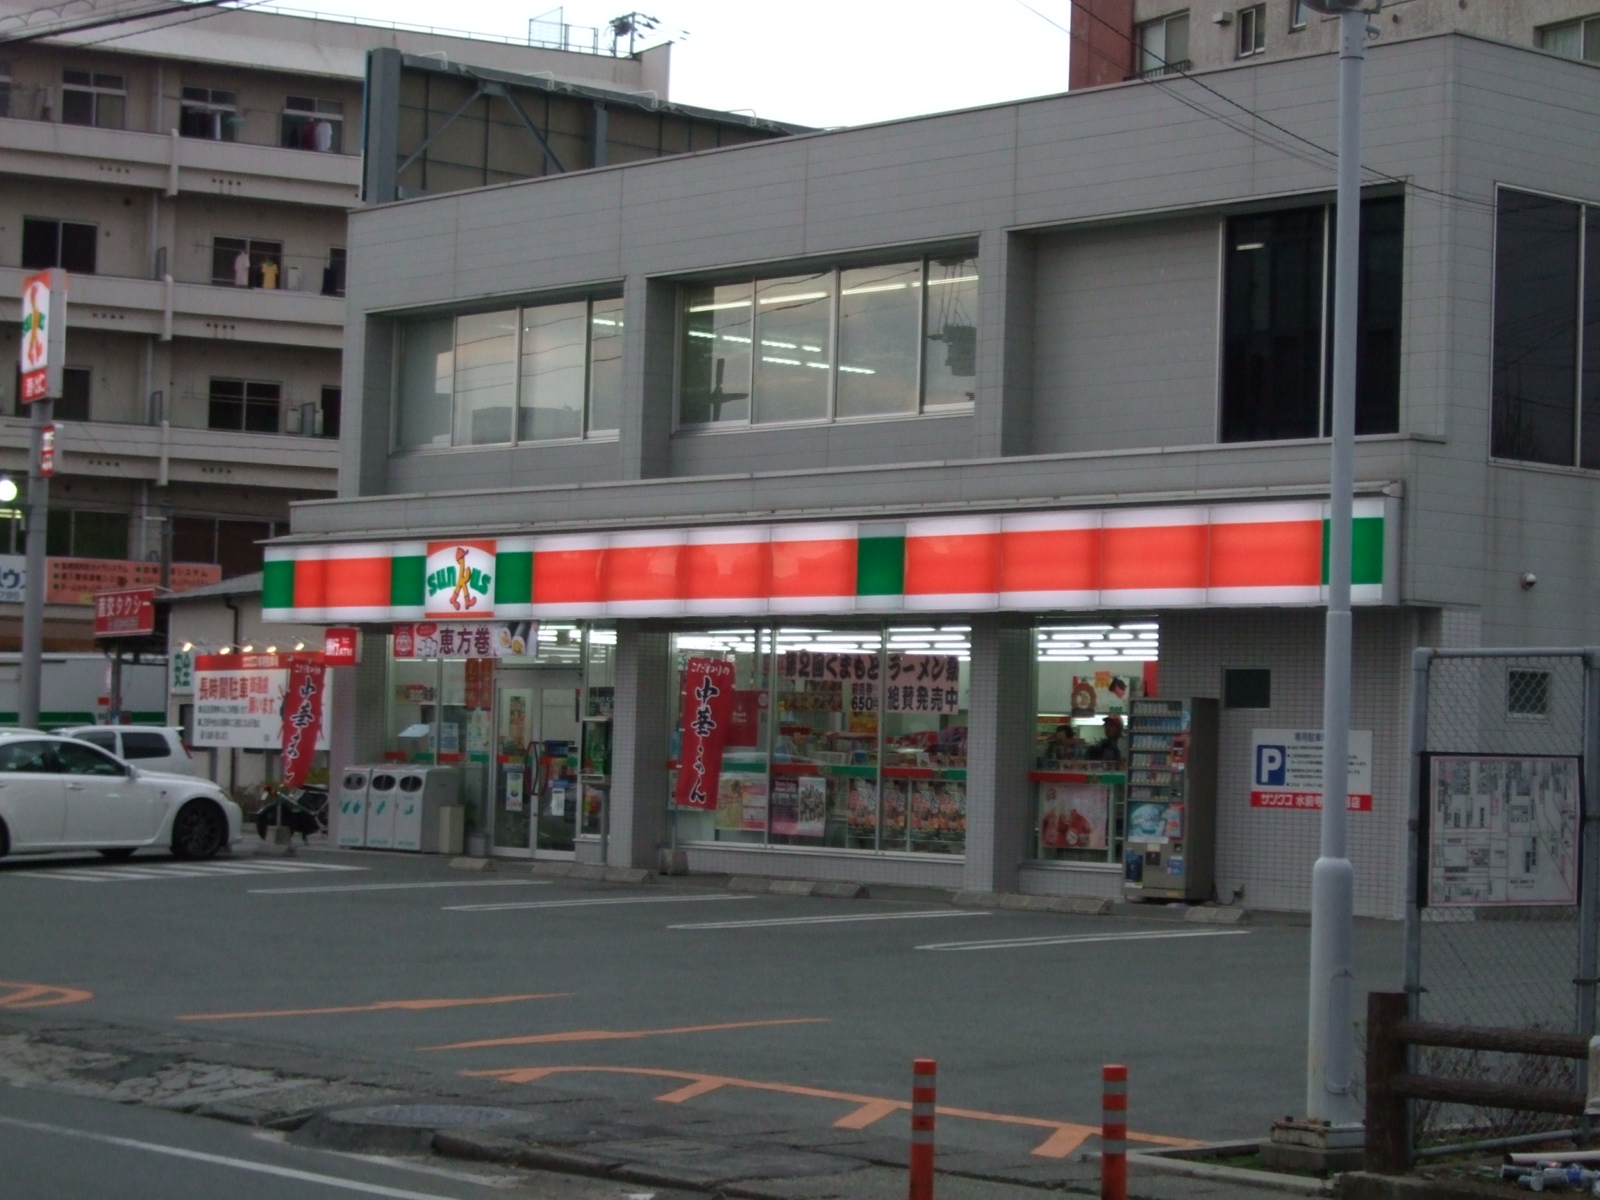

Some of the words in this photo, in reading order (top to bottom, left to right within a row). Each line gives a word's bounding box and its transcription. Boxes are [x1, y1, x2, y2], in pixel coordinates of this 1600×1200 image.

[439, 627, 491, 655] 恵方巻
[691, 662, 731, 677] こだわりの
[199, 676, 249, 701] 長時間駐車
[887, 686, 959, 712] 絶賛発売中
[1294, 732, 1325, 743] 専用駐車
[1261, 747, 1283, 783] P
[1260, 793, 1293, 806] サンクス
